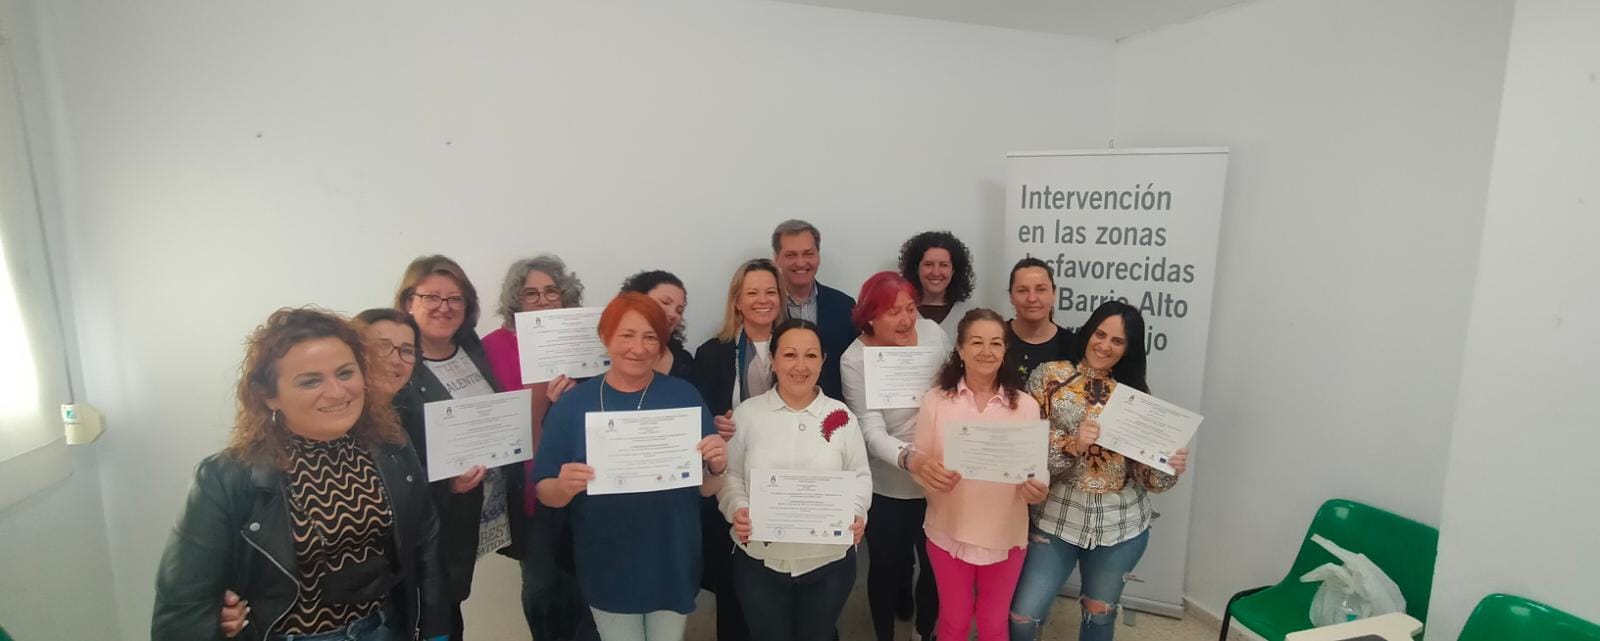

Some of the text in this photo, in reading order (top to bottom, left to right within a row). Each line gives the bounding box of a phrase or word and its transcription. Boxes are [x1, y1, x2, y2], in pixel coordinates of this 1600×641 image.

[1021, 183, 1172, 211] Intervención
[1018, 219, 1167, 247] en las zonas
[1025, 252, 1195, 284] sfavorecidas
[1139, 291, 1188, 318] Alto
[1144, 325, 1168, 356] jo
